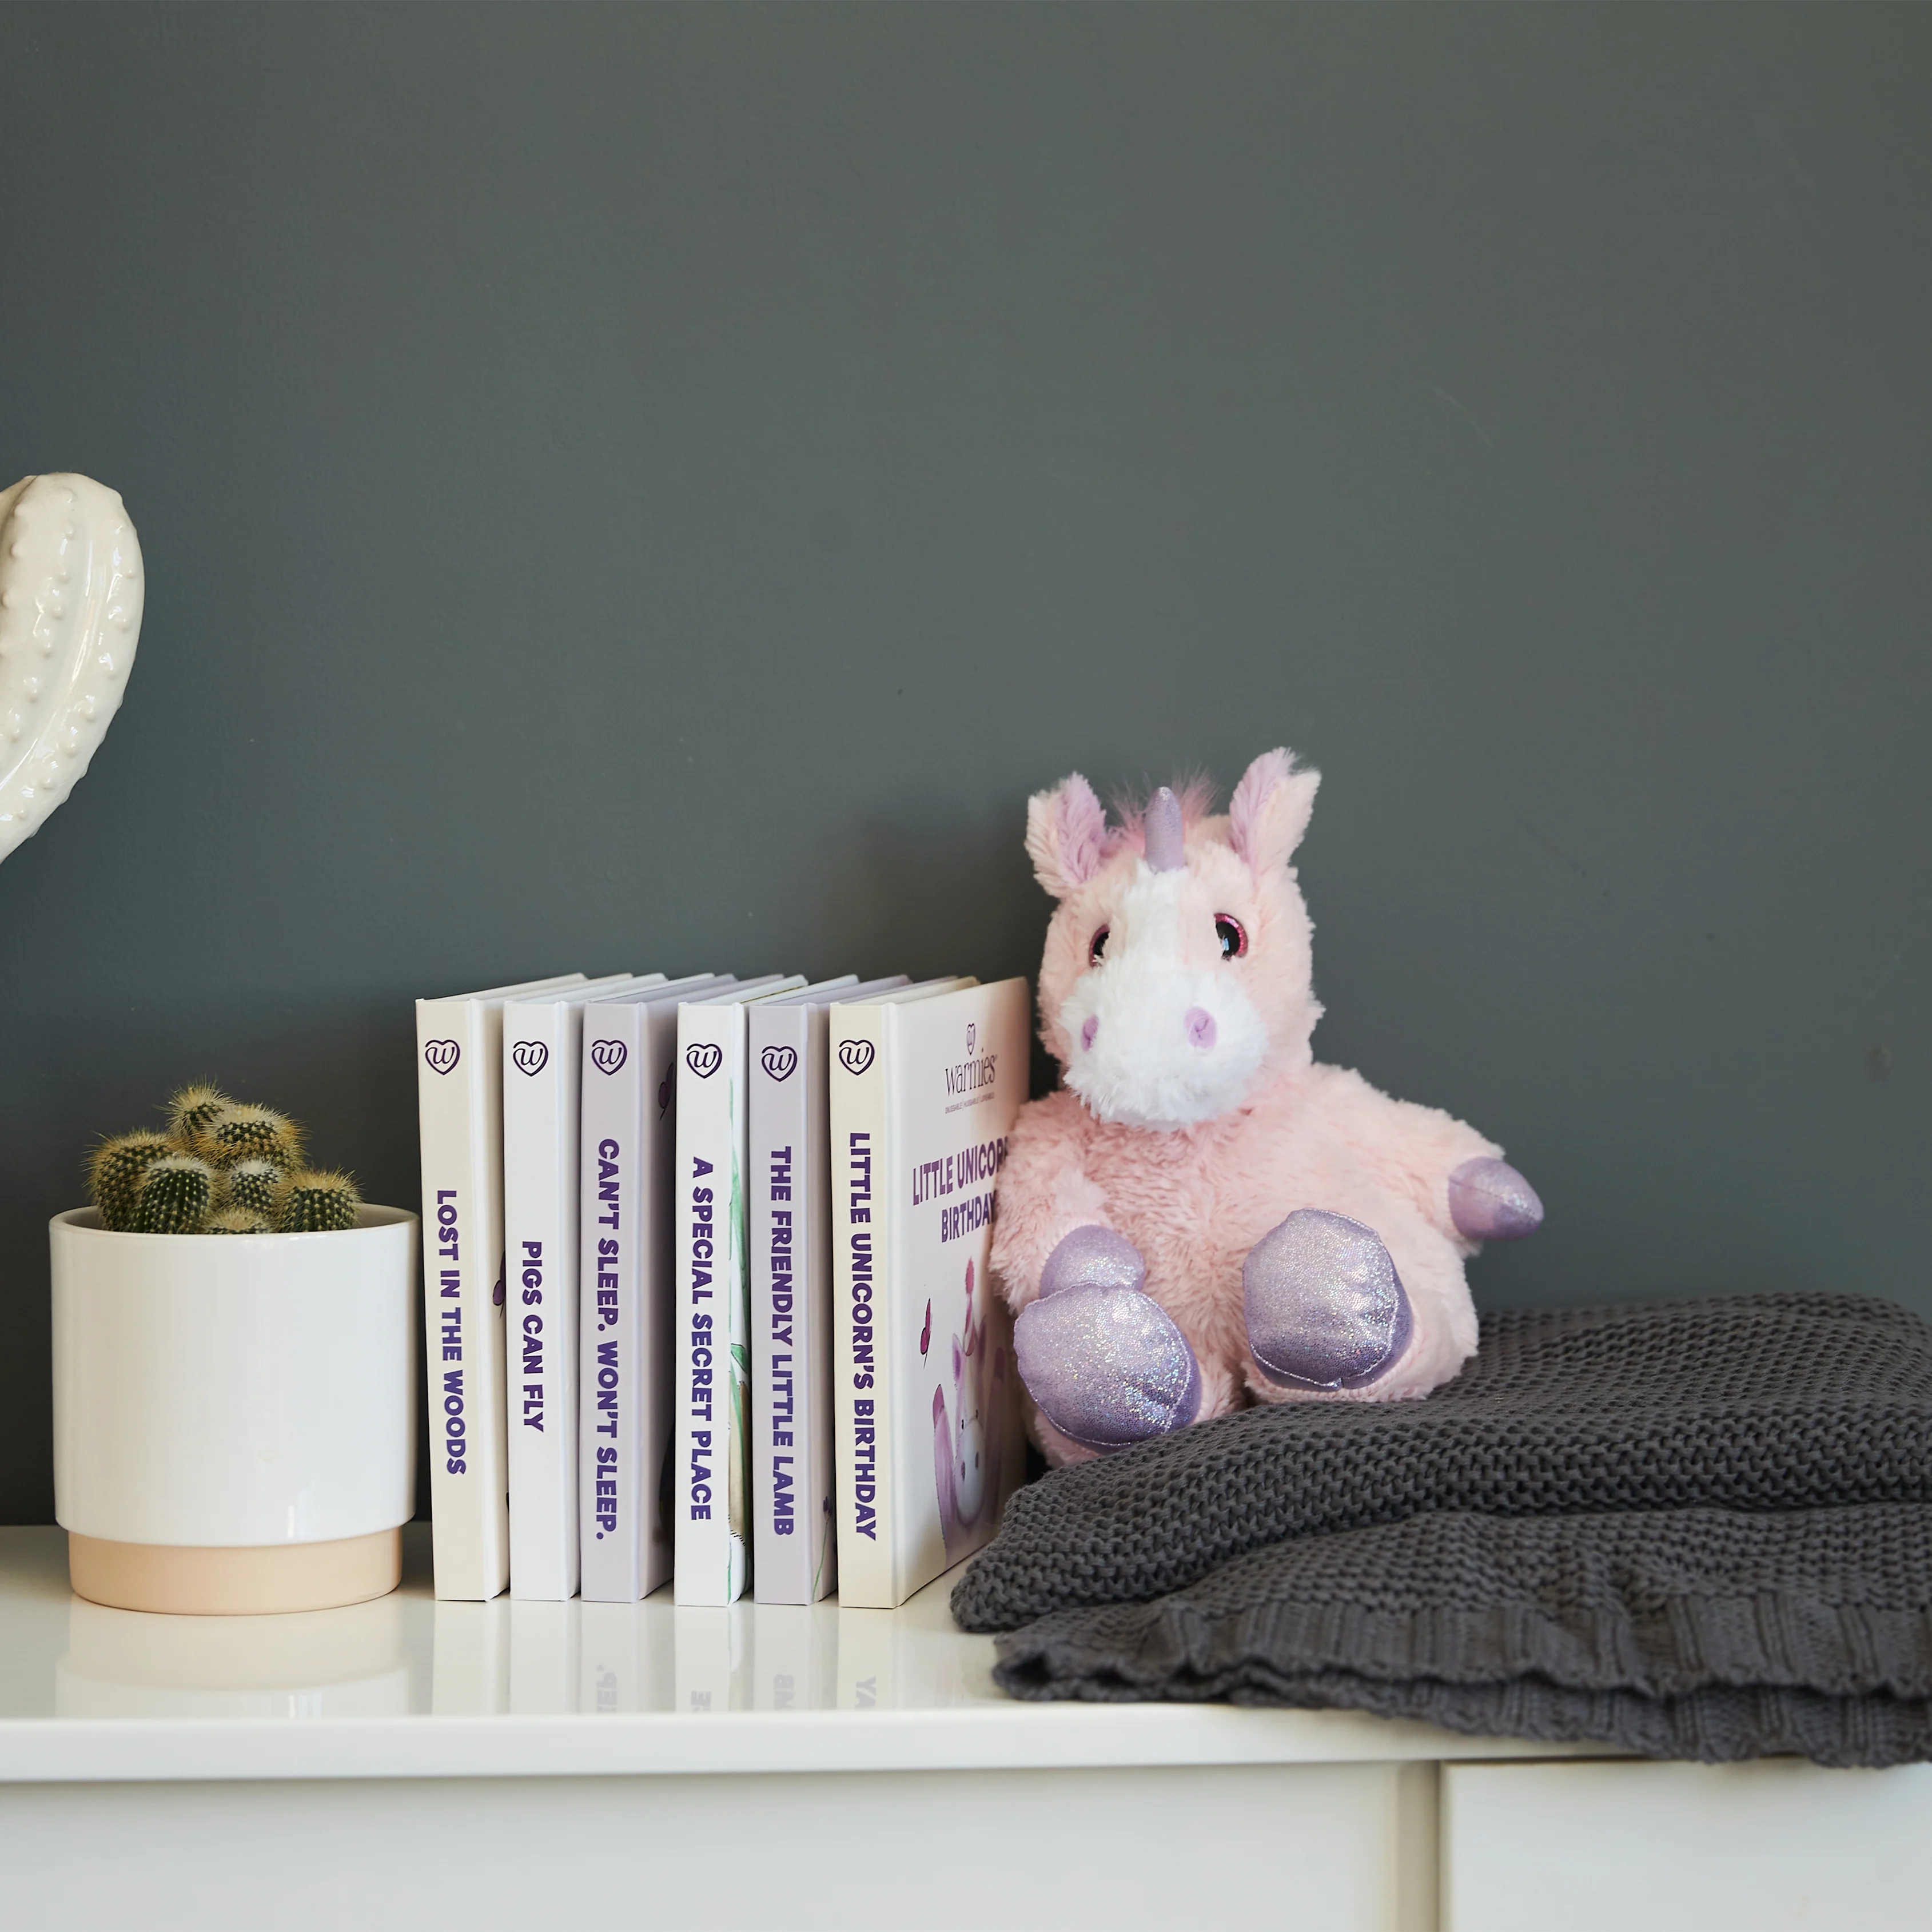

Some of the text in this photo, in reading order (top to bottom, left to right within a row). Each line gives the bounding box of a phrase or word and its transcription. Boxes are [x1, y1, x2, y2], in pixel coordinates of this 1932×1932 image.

[437, 1190, 467, 1475] LOST IN THE WOODS
[522, 1241, 544, 1432] PIGS CAN FLY
[596, 1138, 620, 1540] CAN'T SLEEP. WON'T SLEEP.
[691, 1156, 714, 1520] A SPECIAL SECRET PLACE
[770, 1146, 794, 1536] THE FRIENDLY LITTLE LAMB
[850, 1133, 877, 1541] LITTLE UNICORN'S BIRTHDAY
[913, 1156, 953, 1206] LITTLE
[942, 1189, 997, 1243] BIRTHDAY
